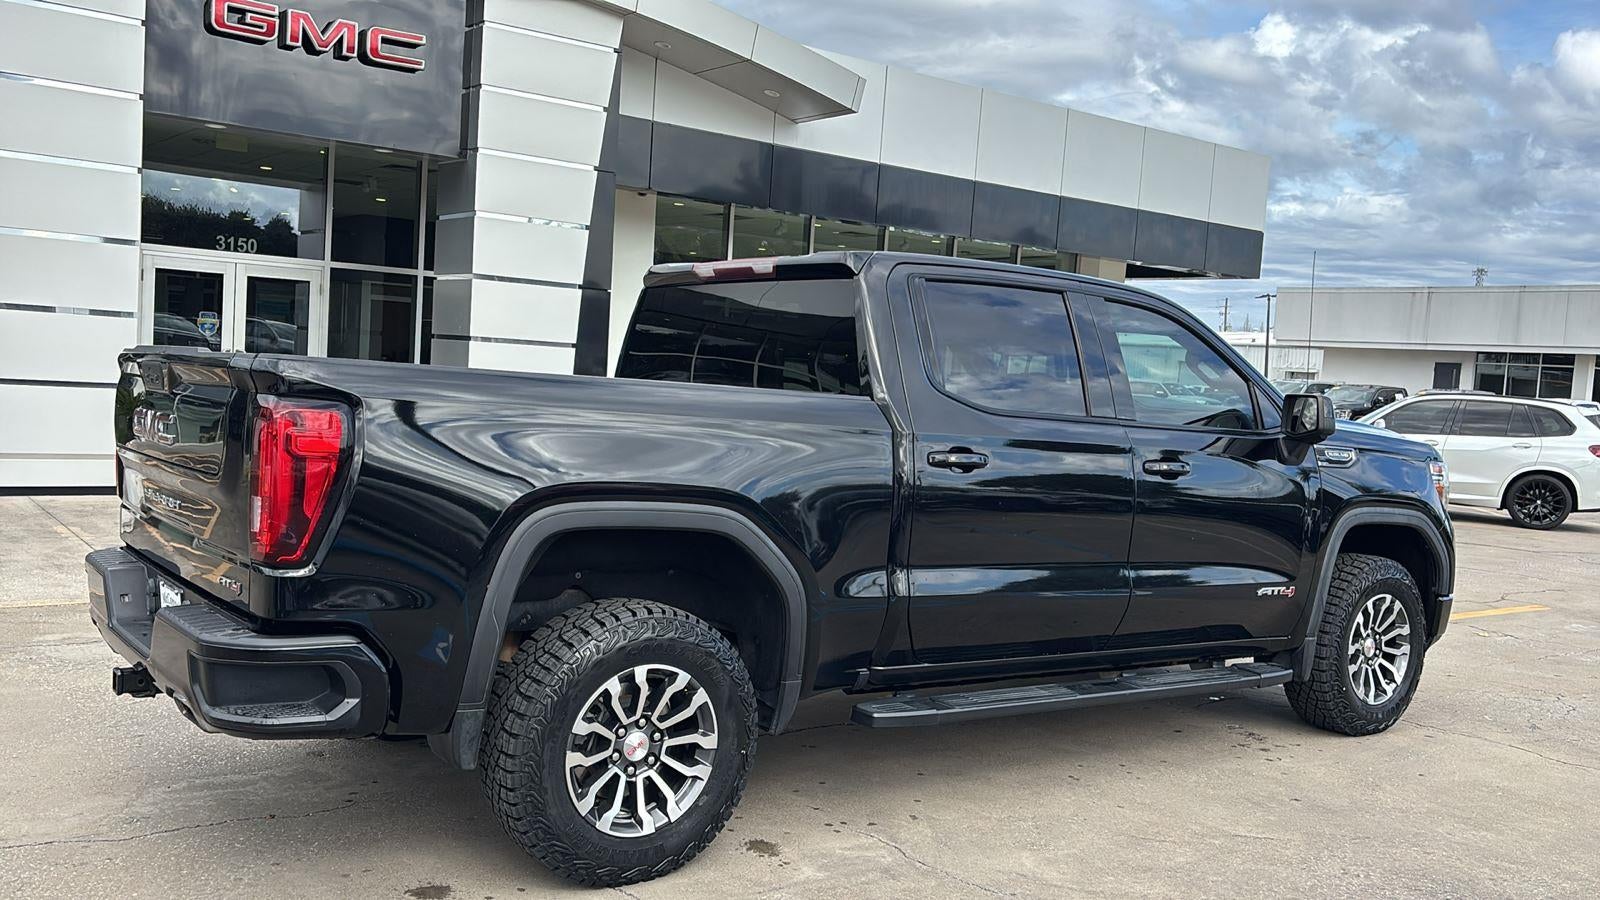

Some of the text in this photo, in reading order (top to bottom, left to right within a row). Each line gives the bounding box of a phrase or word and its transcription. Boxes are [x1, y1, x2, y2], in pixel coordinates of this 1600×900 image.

[205, 0, 427, 73] GMC
[215, 235, 258, 254] 3150
[1256, 586, 1296, 598] AT4
